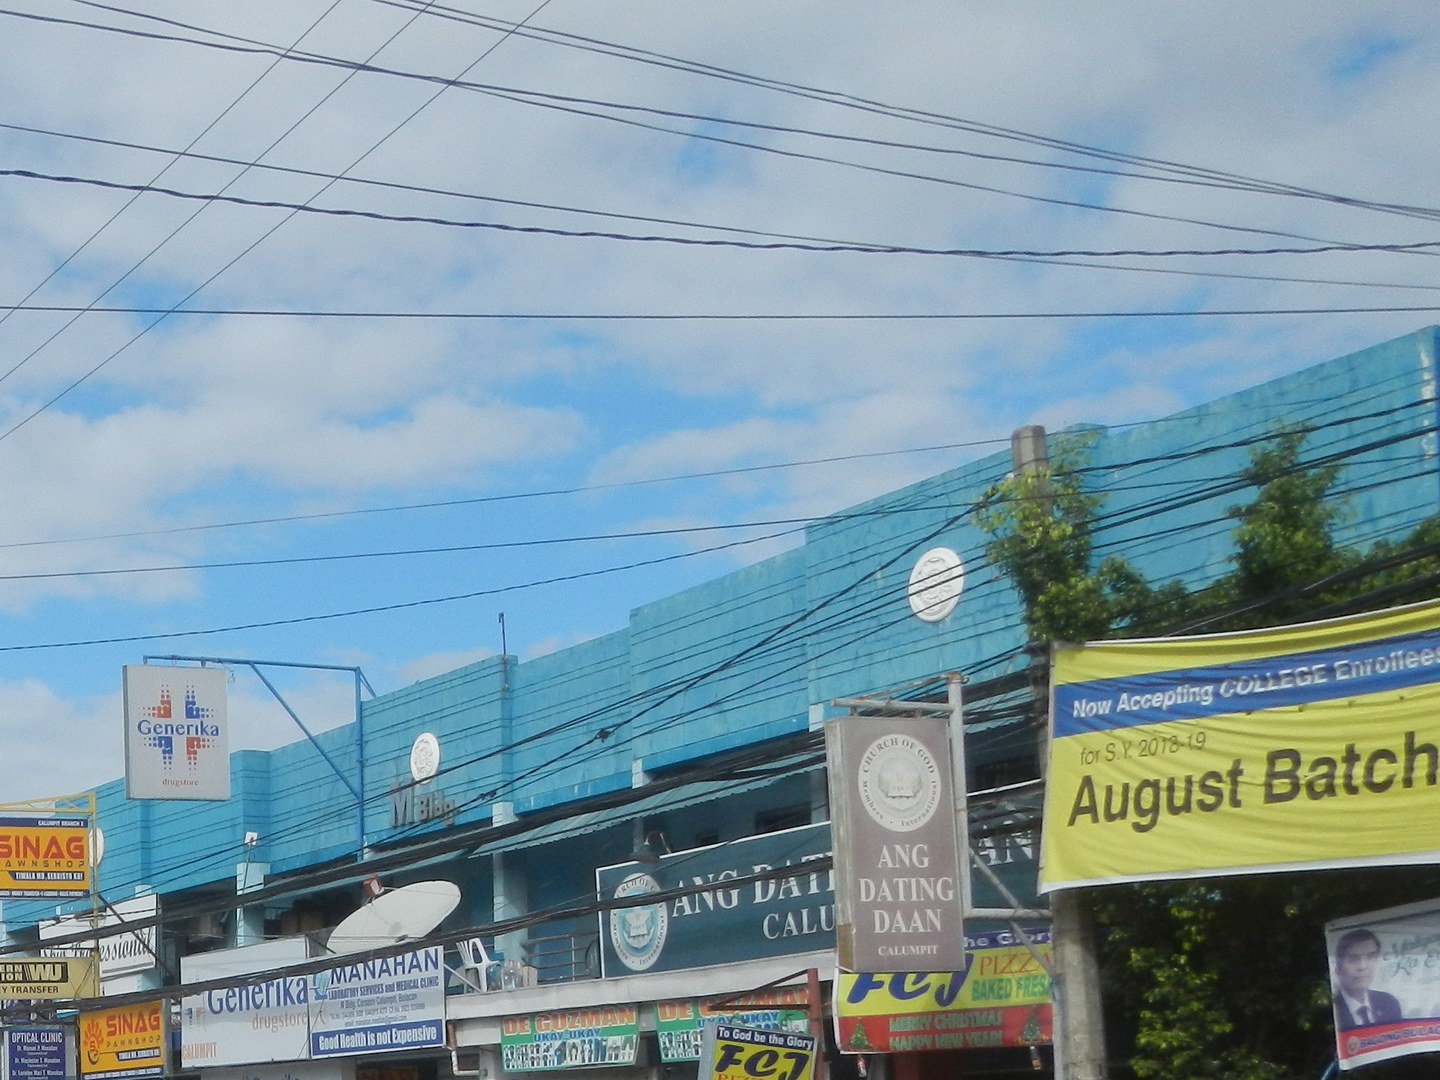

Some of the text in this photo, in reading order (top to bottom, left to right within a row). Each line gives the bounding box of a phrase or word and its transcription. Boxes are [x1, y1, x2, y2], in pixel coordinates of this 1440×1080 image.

[1073, 698, 1112, 718] Now
[1117, 684, 1214, 711] Accepting
[1220, 663, 1328, 698] COLLEGE
[137, 719, 219, 737] Generika
[863, 738, 935, 774] CHURCH OF GOD
[1080, 731, 1206, 766] for S.Y. 2018-19
[161, 777, 199, 788] drugstore
[1066, 731, 1440, 833] August Batch
[863, 780, 937, 827] Members International
[877, 844, 931, 869] ANG
[671, 870, 741, 918] ANG
[858, 877, 955, 902] DATING
[872, 909, 943, 933] DAAN
[878, 945, 939, 956] CALUMPIT
[28, 964, 62, 981] WU
[330, 948, 439, 985] MANAHAN
[10, 985, 59, 994] TRANSFER
[207, 974, 308, 1015] Generika
[328, 975, 439, 1000] LABORATORY SERVICES and MEDICAL CLINIC
[971, 979, 1010, 1001] BAKED
[105, 1008, 160, 1037] SINAG
[252, 1010, 308, 1033] drugstore
[503, 1005, 637, 1036] DE GUZMAN
[889, 1017, 932, 1032] MERRY
[11, 1032, 63, 1043] OPTICAL CLINIC
[105, 1035, 160, 1047] PAWNSHOP
[320, 1025, 437, 1051] Good Health is not Expensive
[718, 1027, 814, 1051] To God be the Glory
[889, 1036, 932, 1051] HAPPY
[935, 1033, 965, 1049] NEW
[181, 1042, 217, 1060] CALUMPIT
